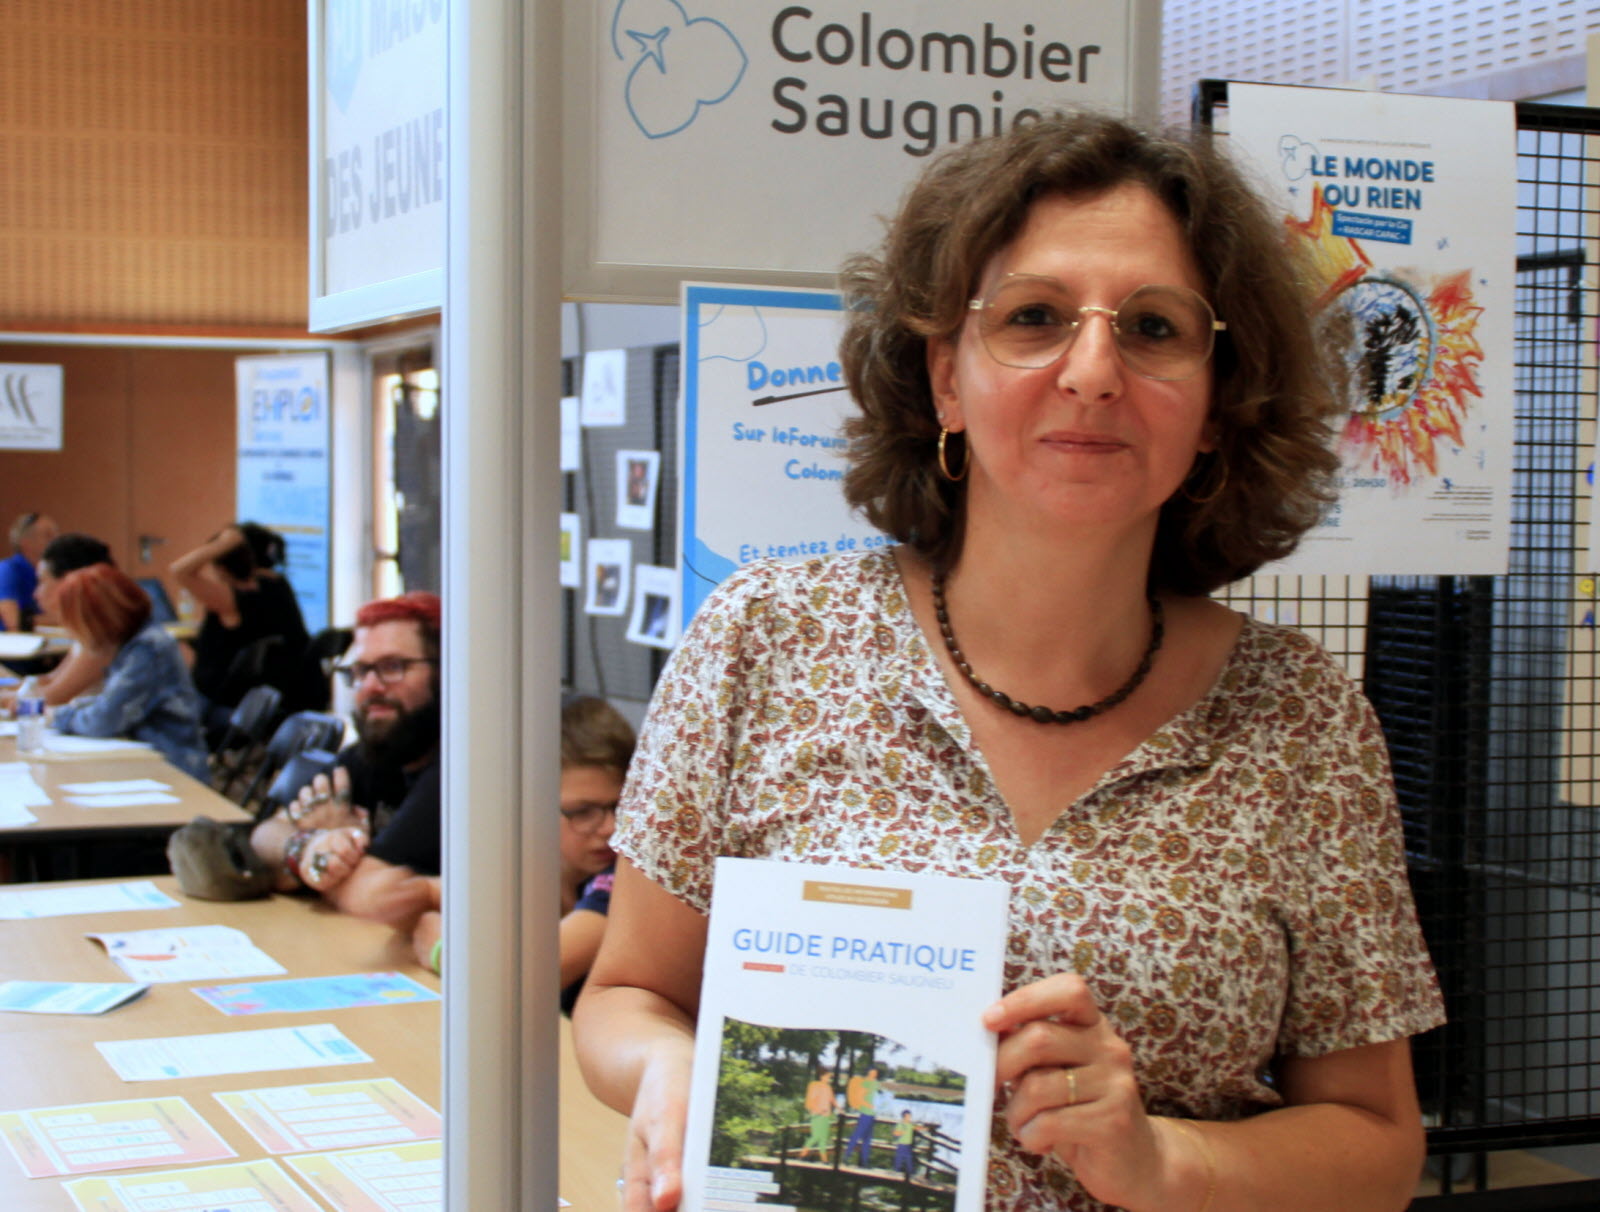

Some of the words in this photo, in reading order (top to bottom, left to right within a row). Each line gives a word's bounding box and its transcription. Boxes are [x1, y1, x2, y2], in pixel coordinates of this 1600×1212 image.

[771, 6, 1101, 84] Colombier
[771, 77, 1050, 157] Saugni
[1311, 155, 1338, 177] LE
[1344, 157, 1435, 182] MONDE
[326, 143, 362, 239] DES
[1323, 184, 1360, 207] OU
[1367, 186, 1422, 210] RIEN
[747, 360, 842, 391] Donne
[733, 421, 766, 442] Sur
[785, 459, 851, 481] Colom
[739, 544, 760, 564] Et
[768, 540, 829, 559] tentez
[835, 533, 857, 552] de
[732, 928, 824, 958] GUIDE
[831, 936, 977, 973] PRATIQUE
[789, 963, 807, 977] DE
